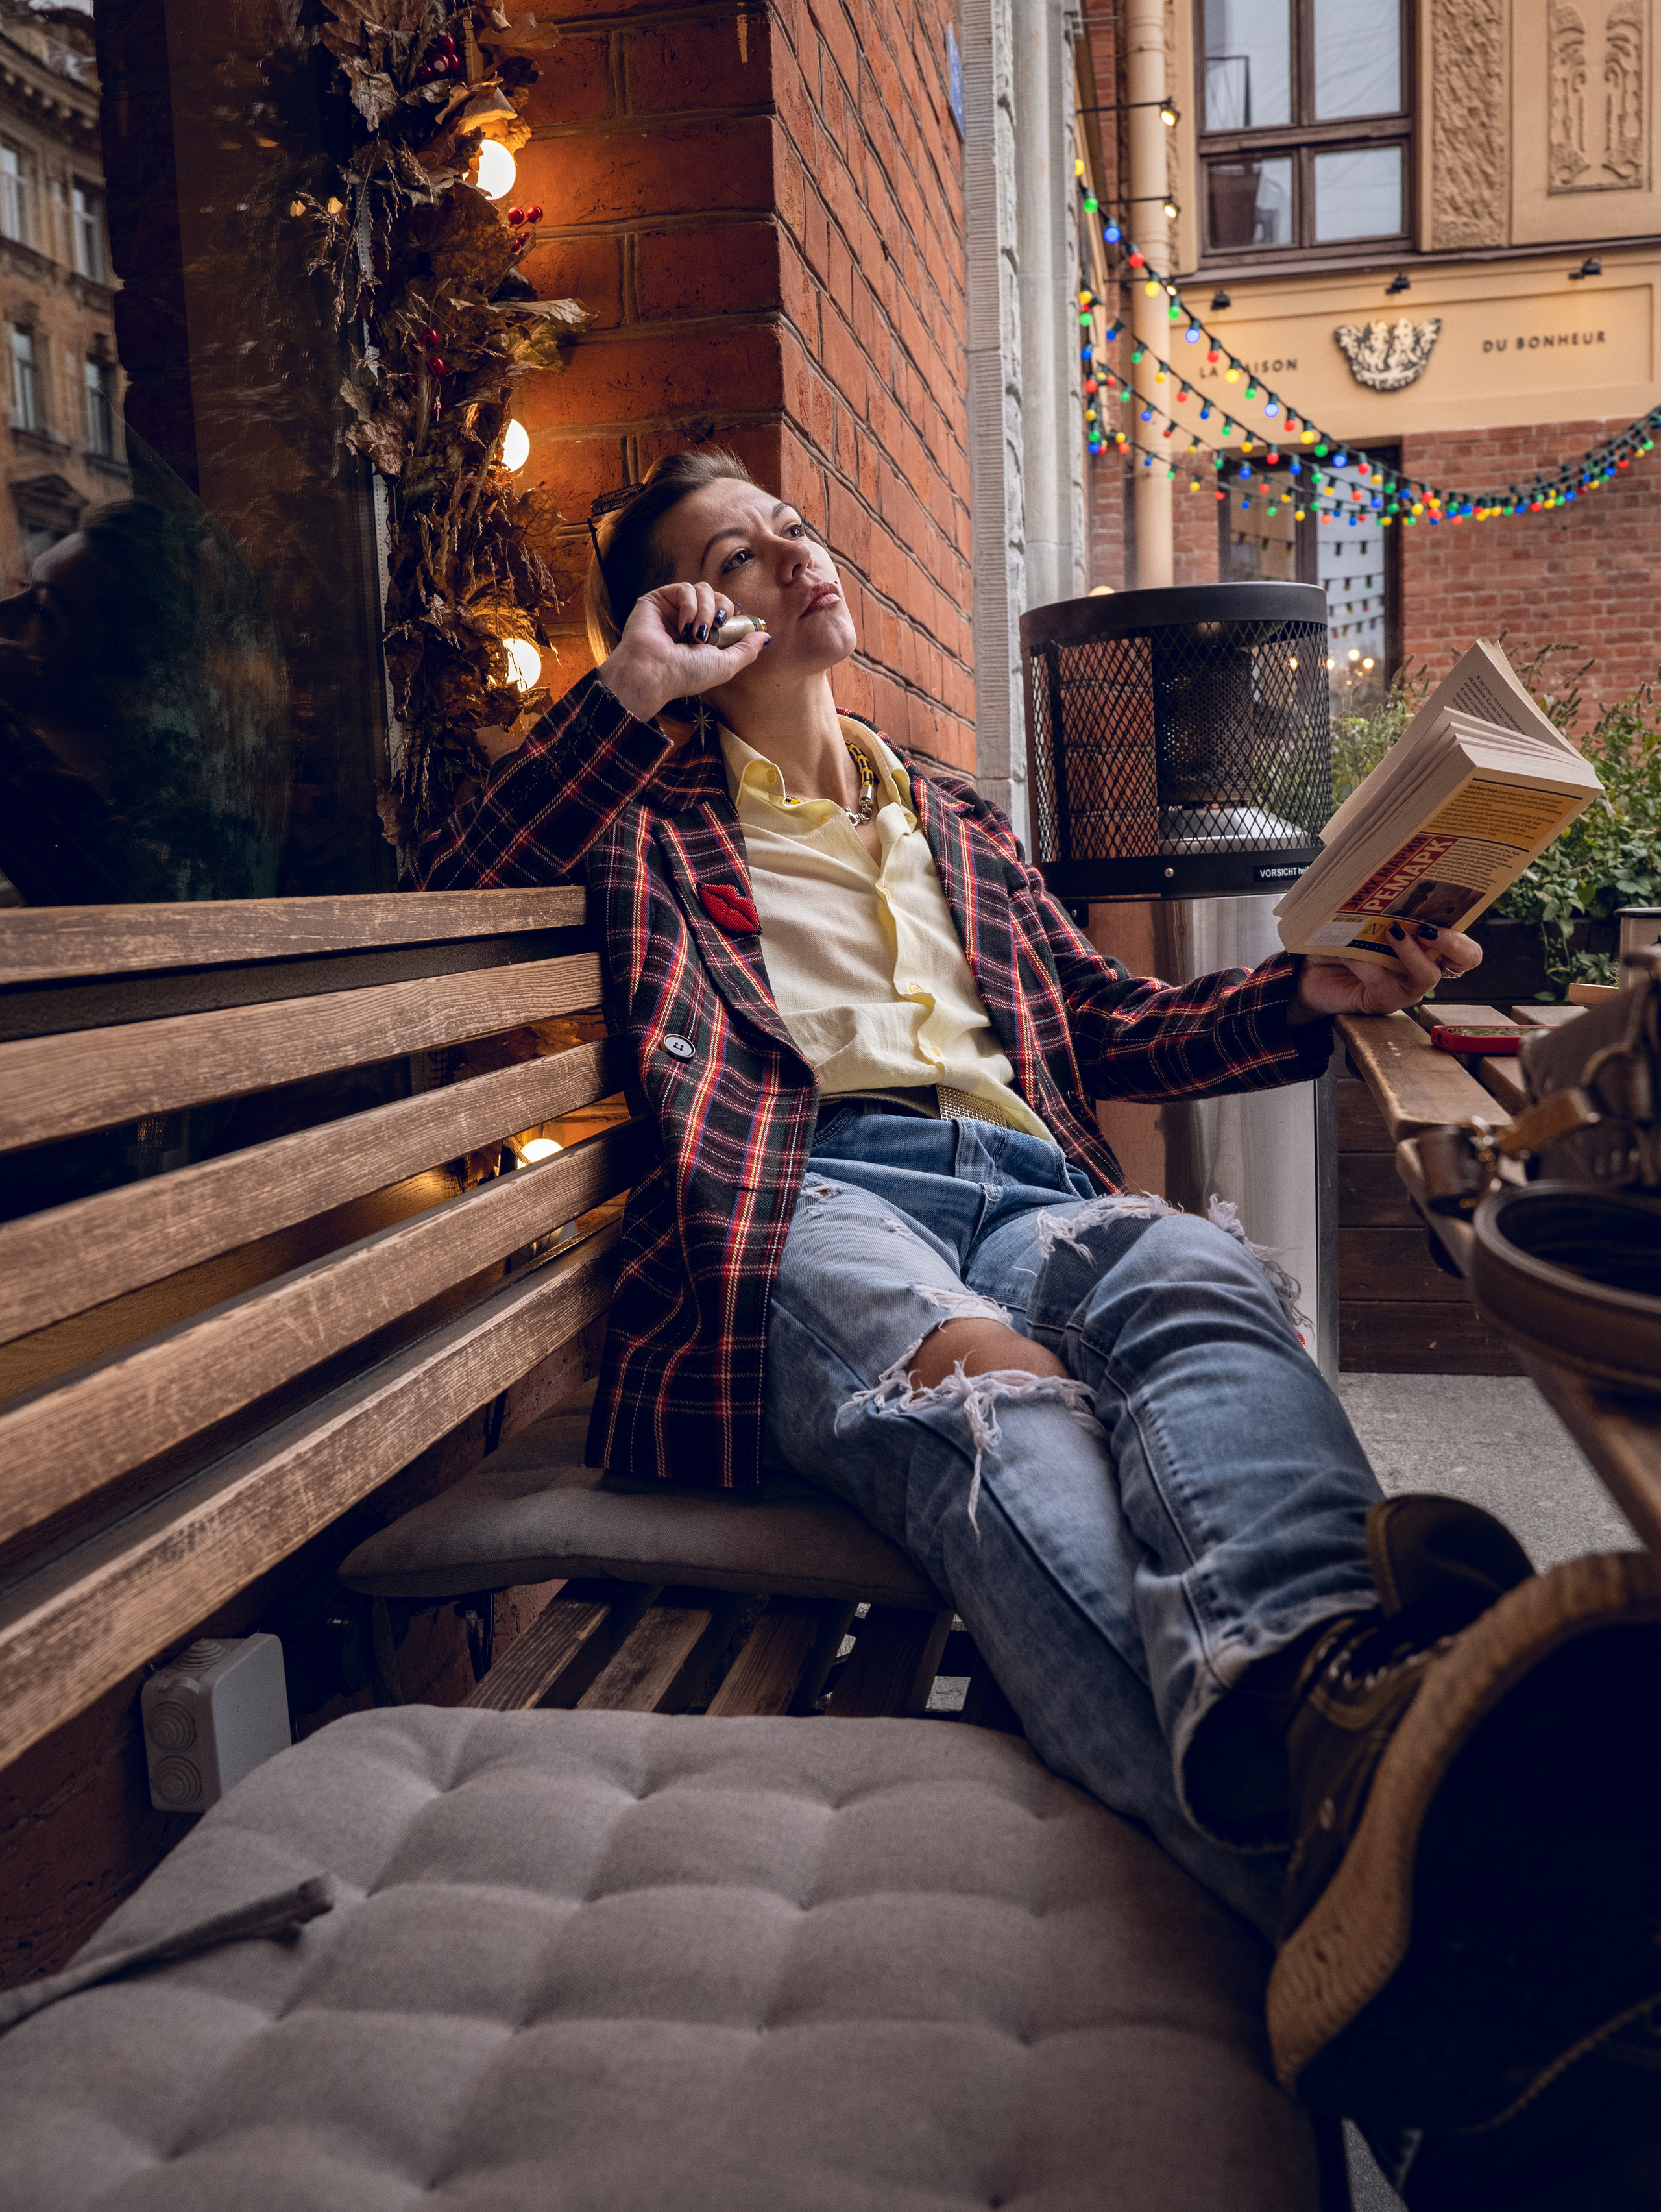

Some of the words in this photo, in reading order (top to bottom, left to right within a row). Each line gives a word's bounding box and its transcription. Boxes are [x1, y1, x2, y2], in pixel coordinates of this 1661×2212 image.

[1483, 339, 1507, 353] DU
[1516, 330, 1606, 350] BONHEUR
[1200, 367, 1218, 378] LA
[1229, 359, 1297, 374] AISON
[1259, 867, 1297, 878] VORSICHT
[1344, 879, 1383, 908] ЭРИХ
[1376, 837, 1429, 877] МАРИЯ
[1362, 839, 1454, 911] РЕМАРК
